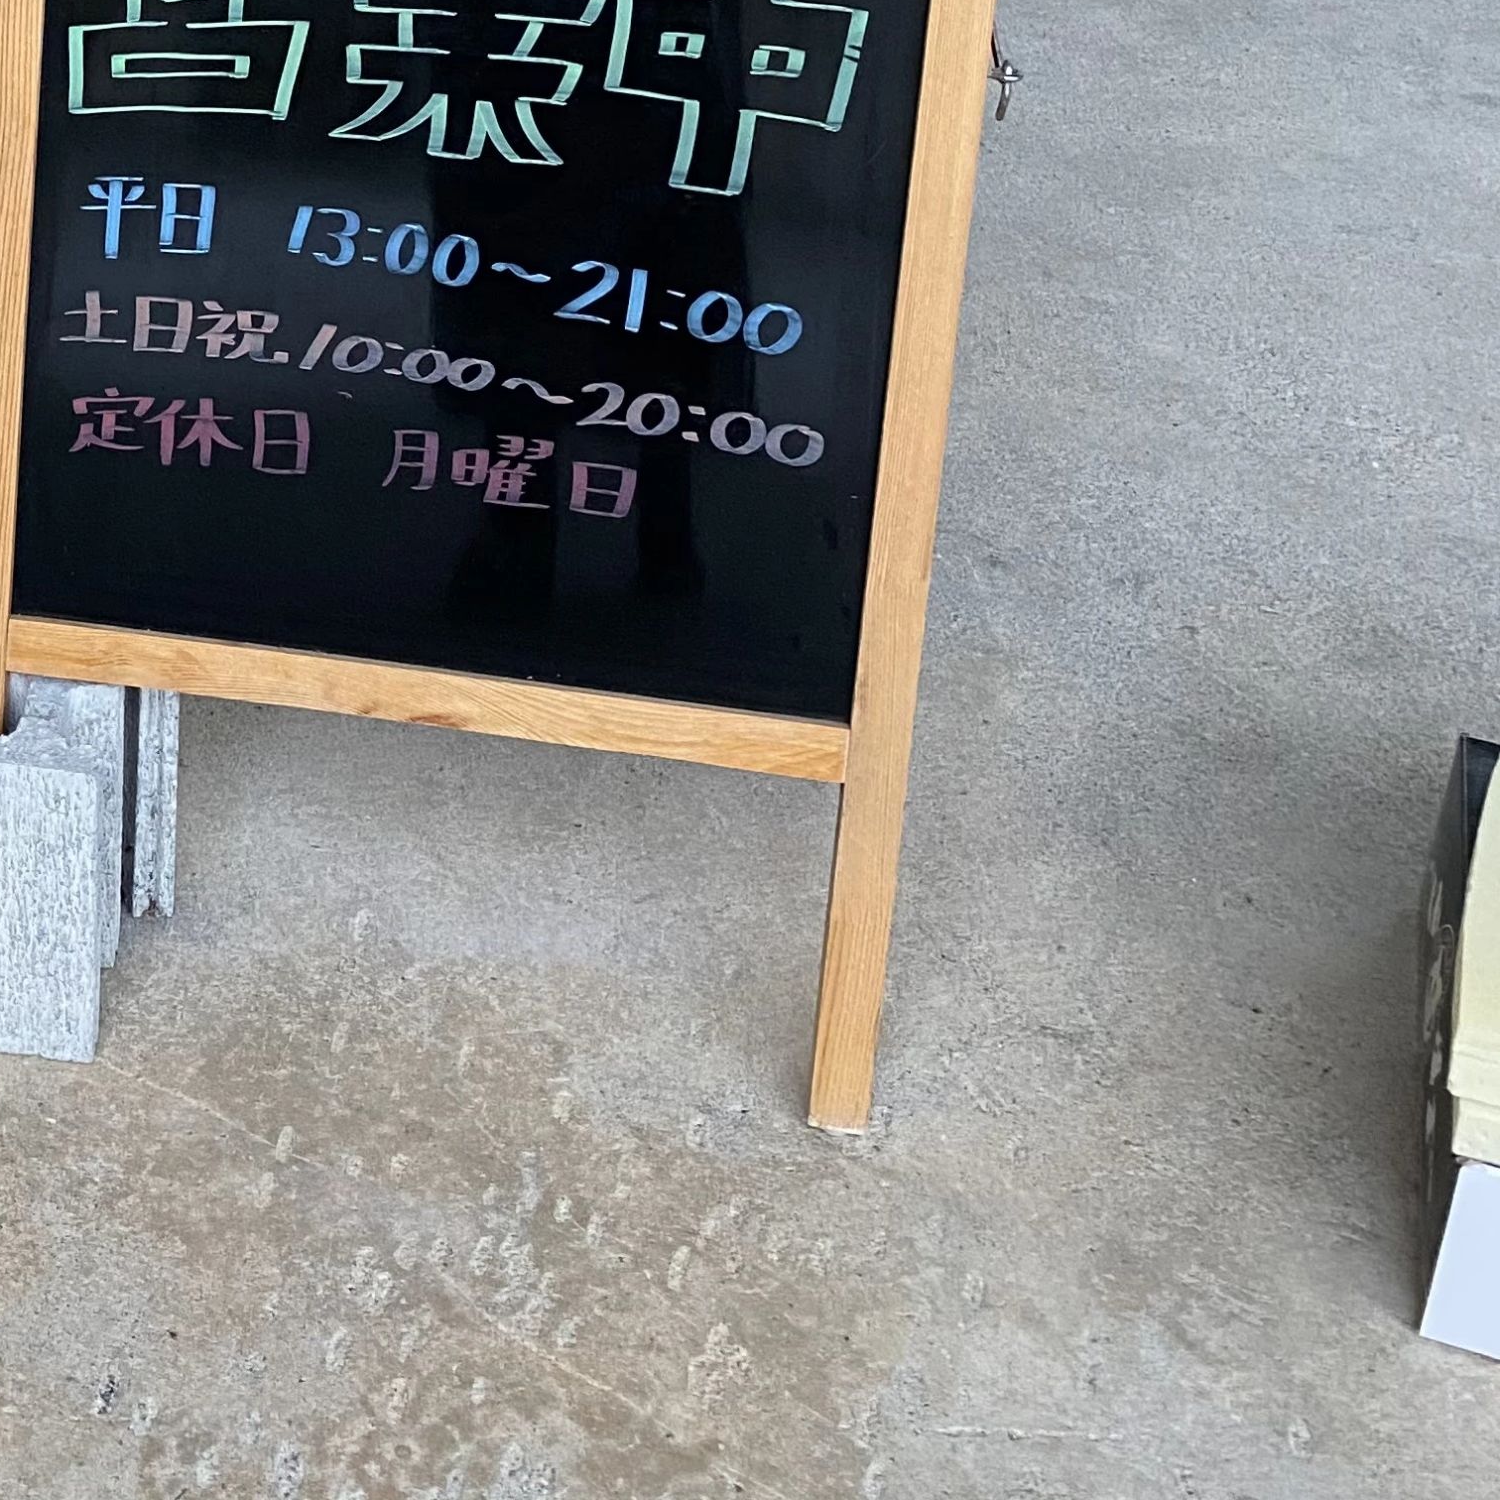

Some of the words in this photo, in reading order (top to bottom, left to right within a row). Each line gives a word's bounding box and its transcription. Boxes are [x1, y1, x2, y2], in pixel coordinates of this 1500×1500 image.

[79, 175, 218, 260] 平日
[58, 289, 290, 364] 土日祝
[68, 386, 311, 476] 定休日
[381, 428, 638, 520] 月曜日
